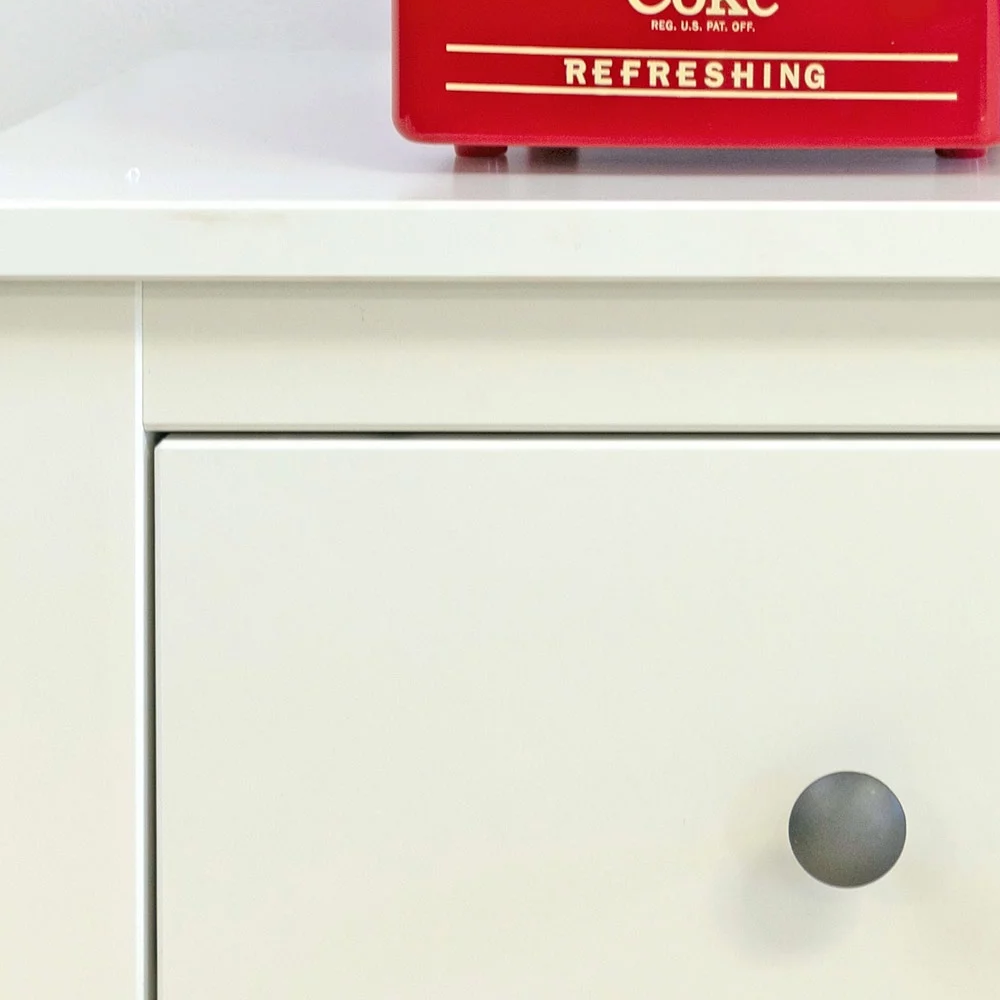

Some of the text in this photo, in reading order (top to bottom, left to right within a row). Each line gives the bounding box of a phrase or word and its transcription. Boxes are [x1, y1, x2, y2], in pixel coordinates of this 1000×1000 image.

[651, 19, 677, 31] REG.
[680, 20, 703, 32] U.S.
[706, 21, 728, 32] PAT.
[564, 58, 826, 90] REFRESHING
